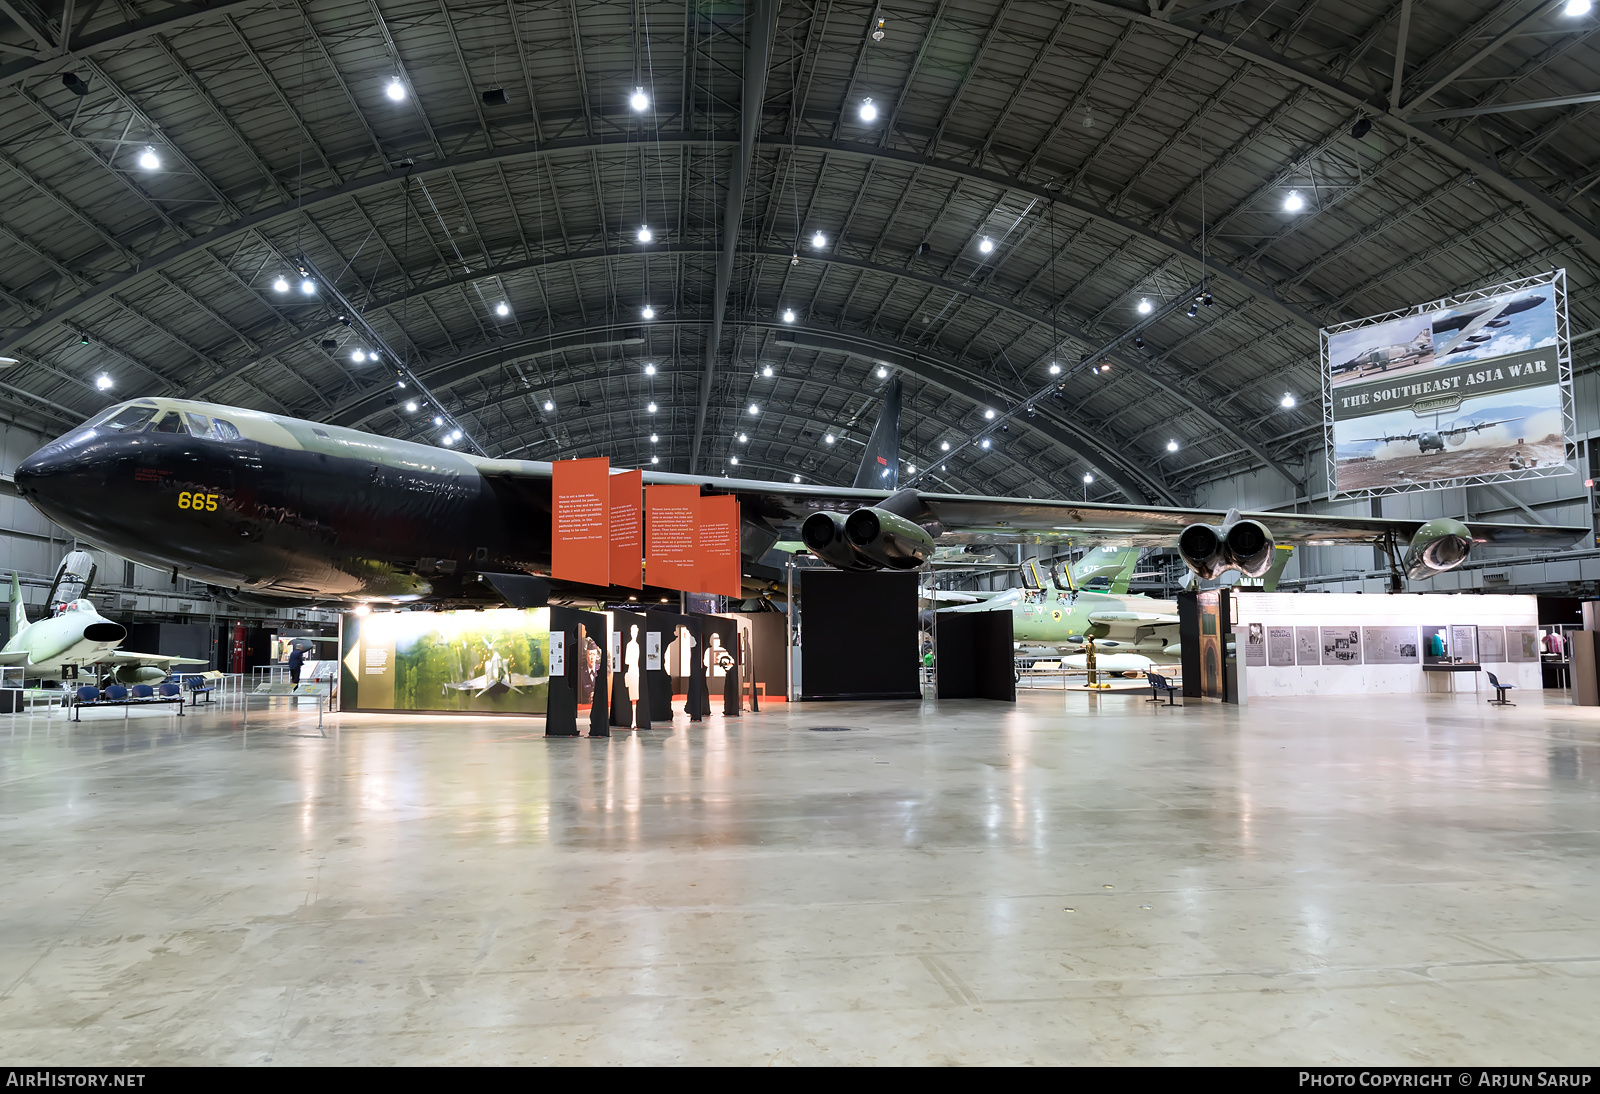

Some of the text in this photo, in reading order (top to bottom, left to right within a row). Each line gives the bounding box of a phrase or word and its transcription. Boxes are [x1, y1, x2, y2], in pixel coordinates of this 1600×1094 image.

[1341, 360, 1548, 408] THE SOUTHEAST ASIA WAR
[178, 492, 219, 512] 665
